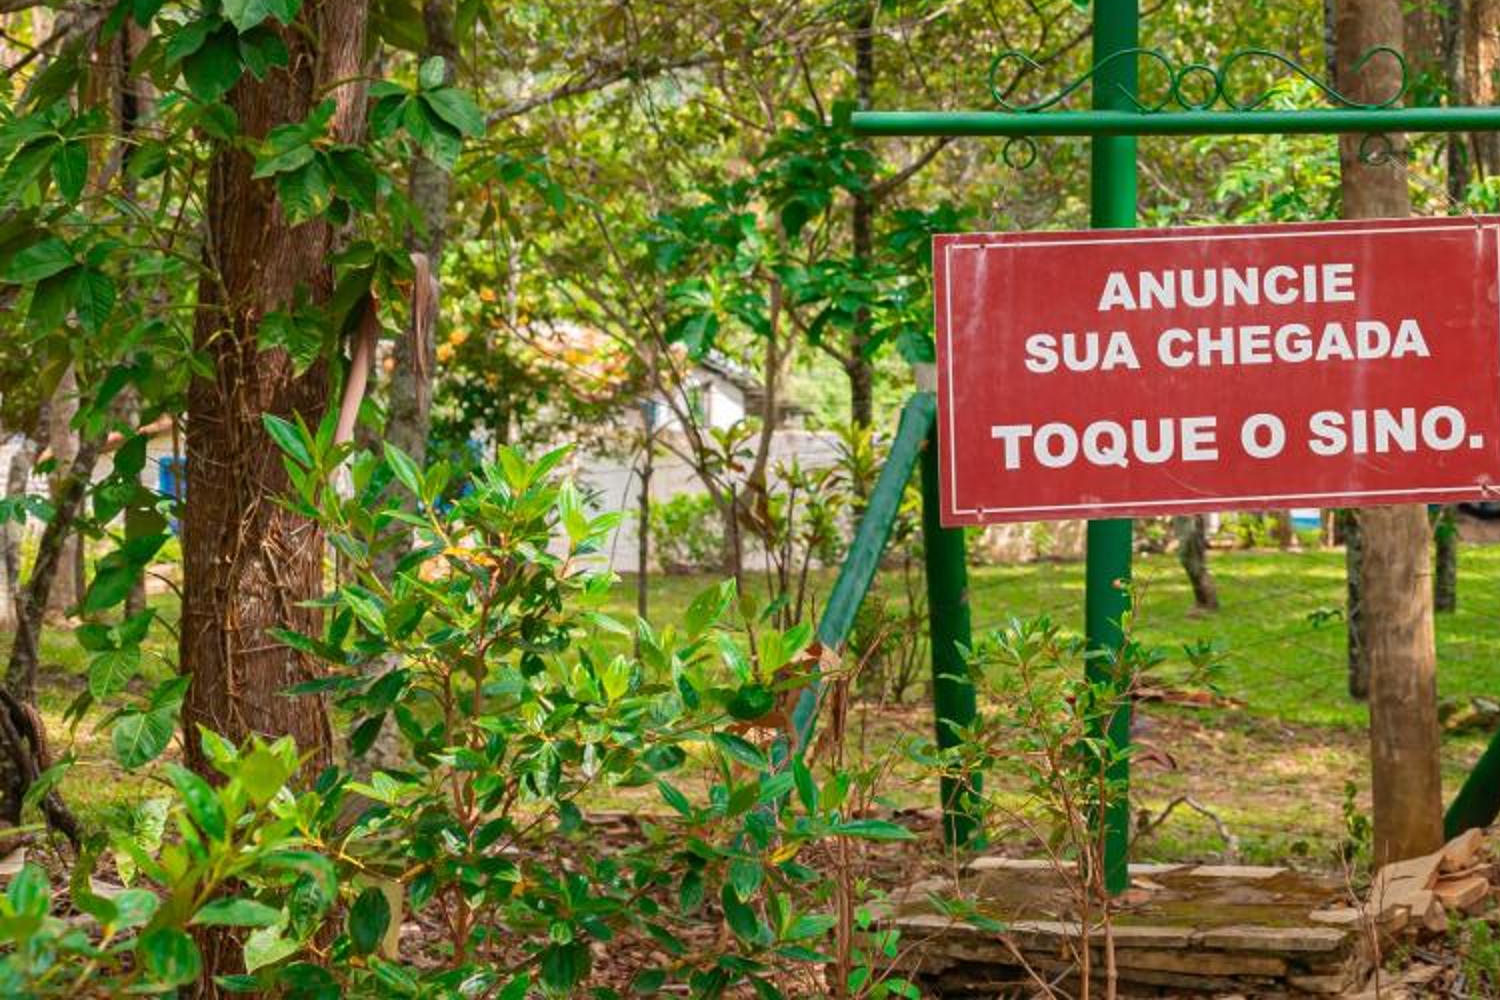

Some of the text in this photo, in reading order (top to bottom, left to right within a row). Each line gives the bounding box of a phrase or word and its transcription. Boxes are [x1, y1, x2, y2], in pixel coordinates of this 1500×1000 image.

[1097, 263, 1356, 311] ANUNCIE
[1024, 319, 1431, 374] SUA CHEGADA
[991, 405, 1485, 470] TOQUE O SINO.
